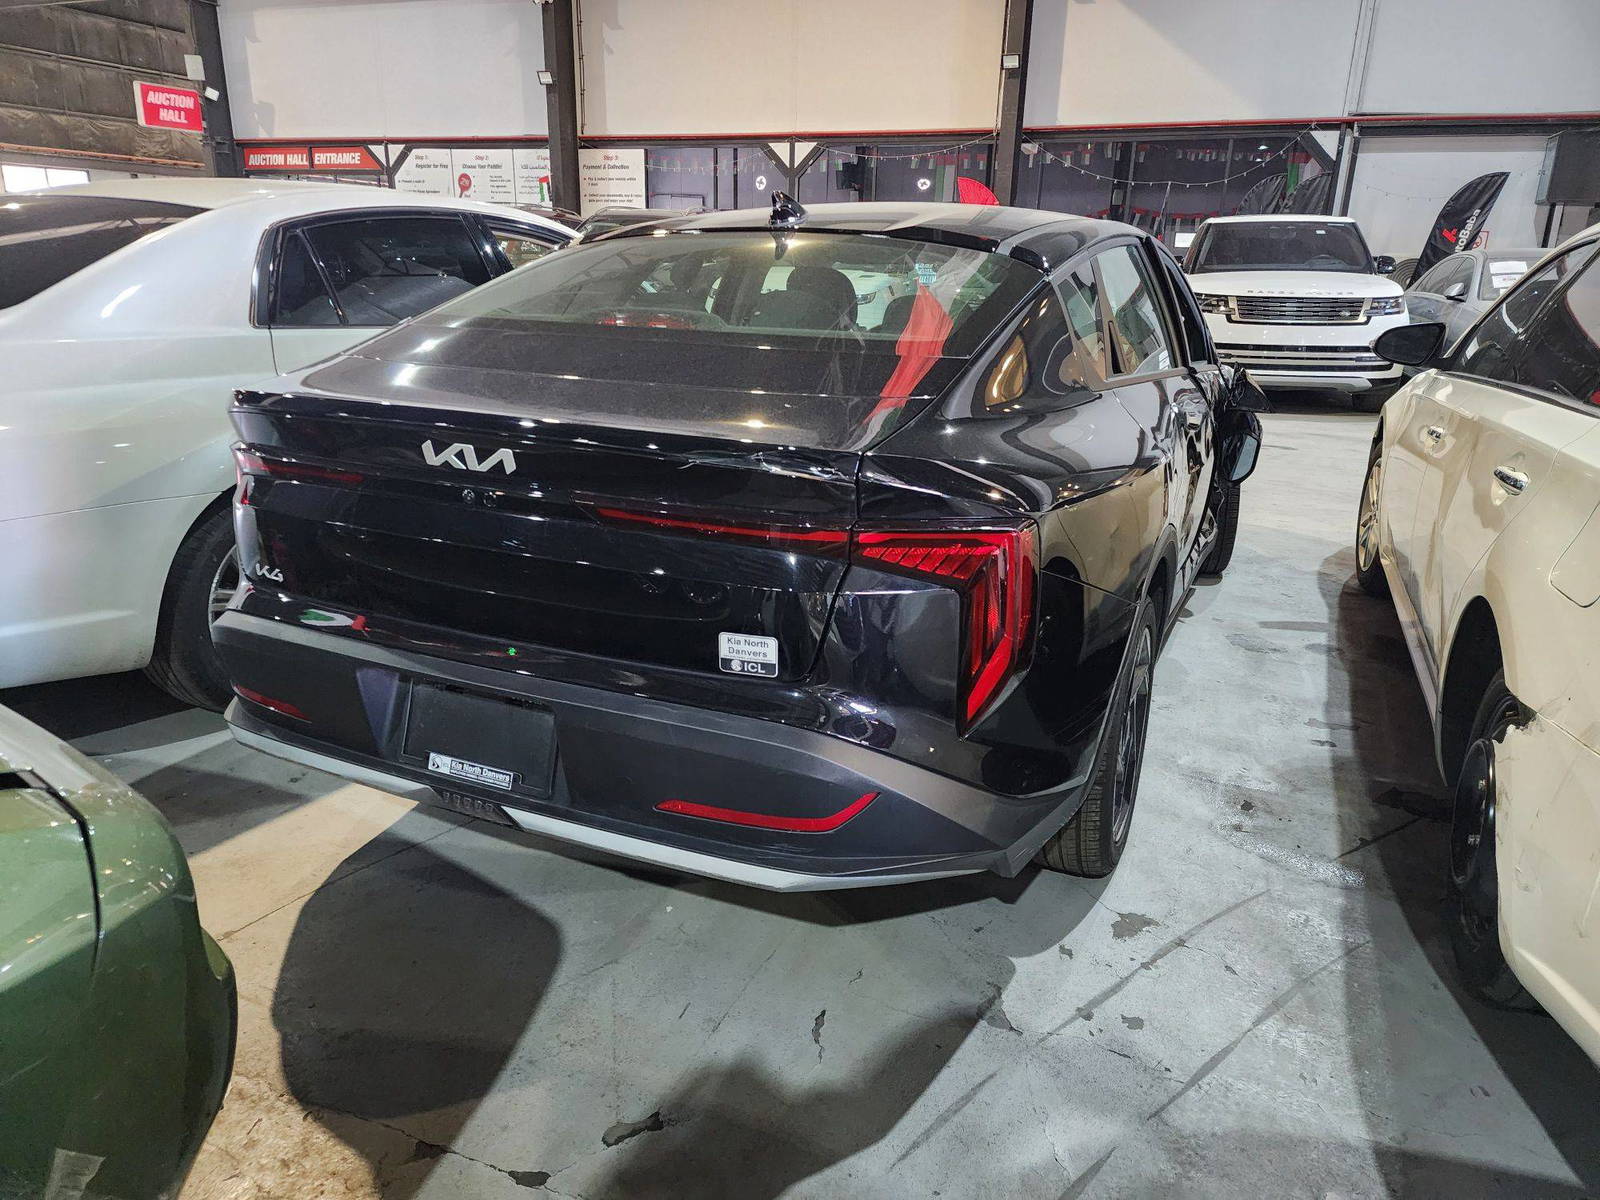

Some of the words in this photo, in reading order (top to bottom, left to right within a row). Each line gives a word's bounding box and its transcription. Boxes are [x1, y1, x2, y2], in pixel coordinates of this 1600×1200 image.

[147, 90, 195, 109] AUCTION
[159, 108, 188, 124] HALL
[249, 154, 285, 166] AUCTION
[286, 153, 309, 165] HALL
[314, 153, 361, 165] ENTRANCE
[421, 439, 517, 475] KIA
[255, 563, 284, 582] K4
[727, 636, 741, 645] Kia
[743, 638, 769, 648] North
[727, 646, 769, 658] Danvers
[744, 662, 766, 673] ICL
[451, 761, 463, 771] Kia
[463, 763, 482, 775] North
[482, 767, 510, 783] Danvers
